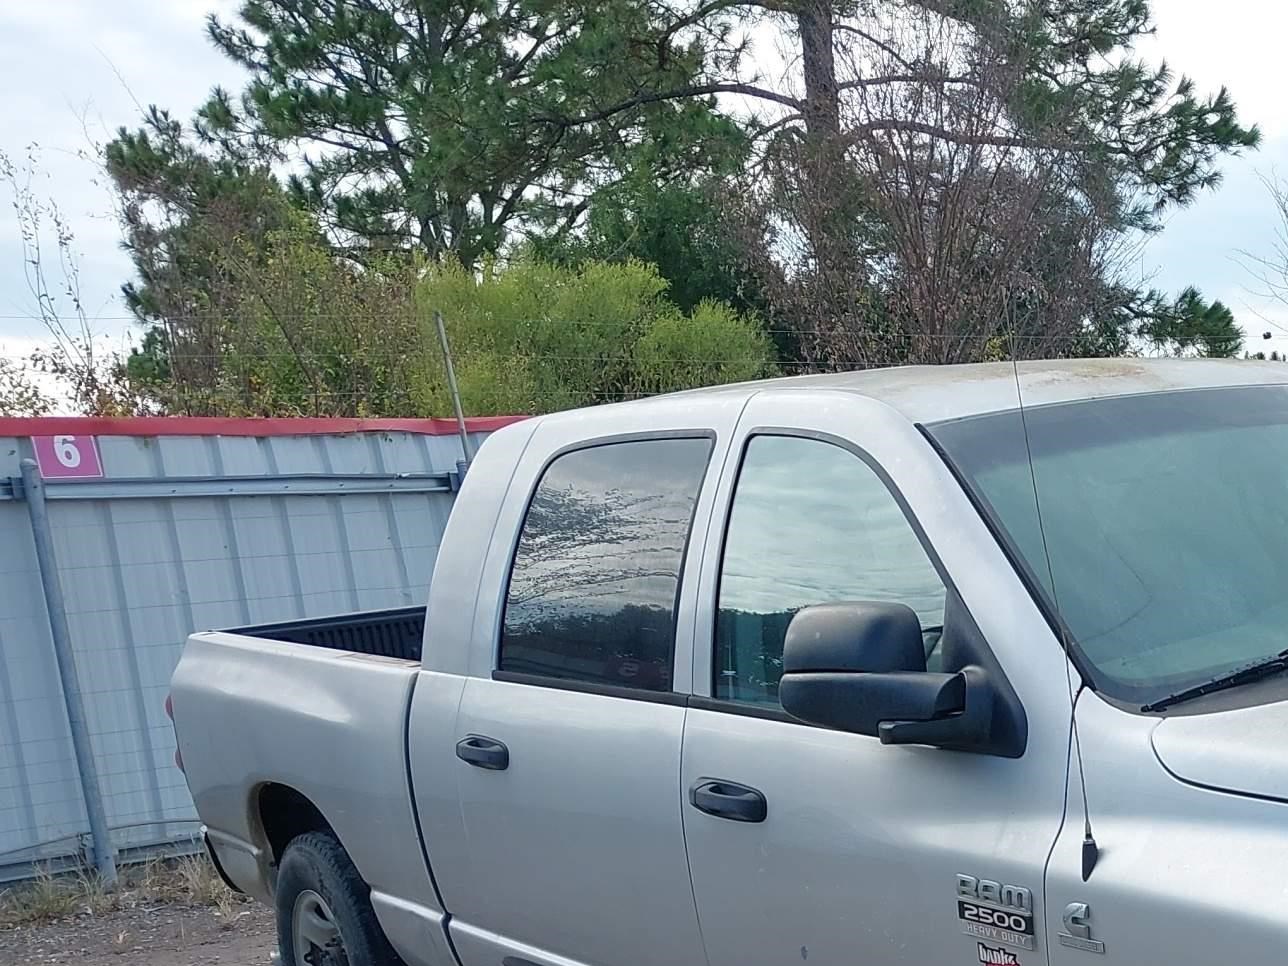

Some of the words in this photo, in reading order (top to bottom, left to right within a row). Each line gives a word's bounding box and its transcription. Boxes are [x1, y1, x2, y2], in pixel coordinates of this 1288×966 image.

[54, 435, 80, 468] 6
[956, 873, 1032, 913] RAM
[964, 904, 1026, 931] 2500
[967, 923, 997, 937] HEAVY
[1001, 931, 1026, 945] DUTY
